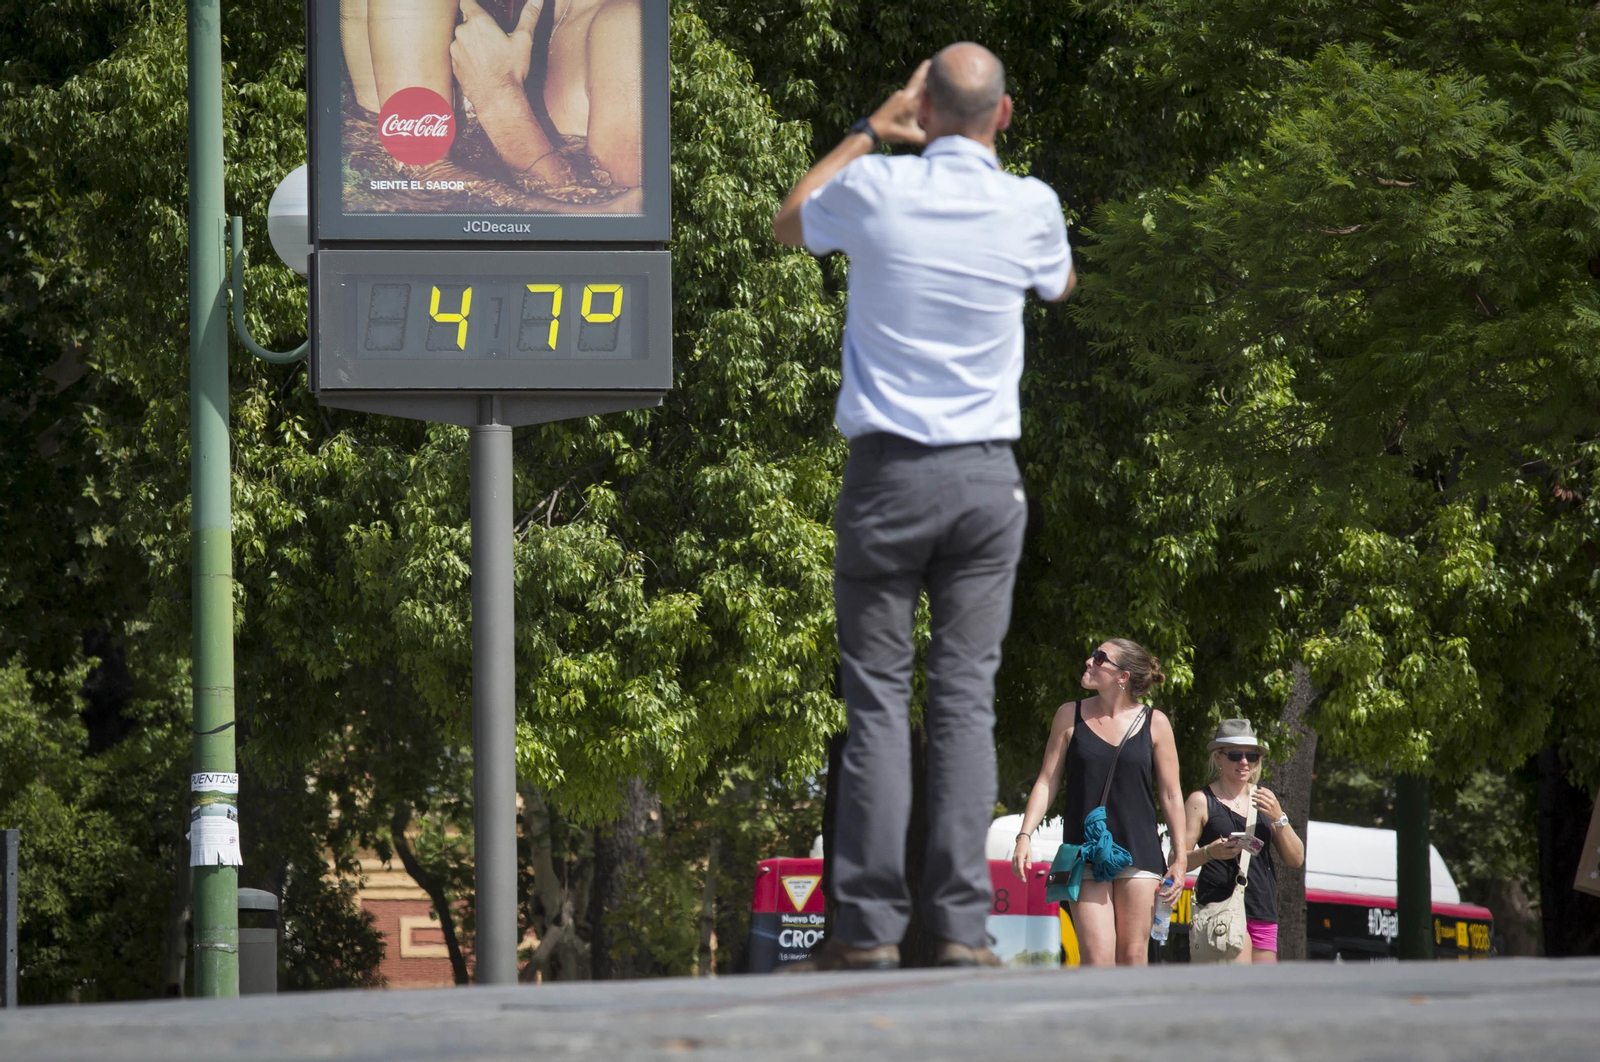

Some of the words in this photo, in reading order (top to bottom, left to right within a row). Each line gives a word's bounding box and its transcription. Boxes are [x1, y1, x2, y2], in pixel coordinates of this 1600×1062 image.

[381, 113, 452, 137] Coca-Cola
[370, 180, 408, 190] SIENTE
[410, 180, 424, 190] EL
[426, 180, 465, 190] SABOR
[463, 220, 531, 234] JCDecaux
[781, 913, 808, 923] Nuevo
